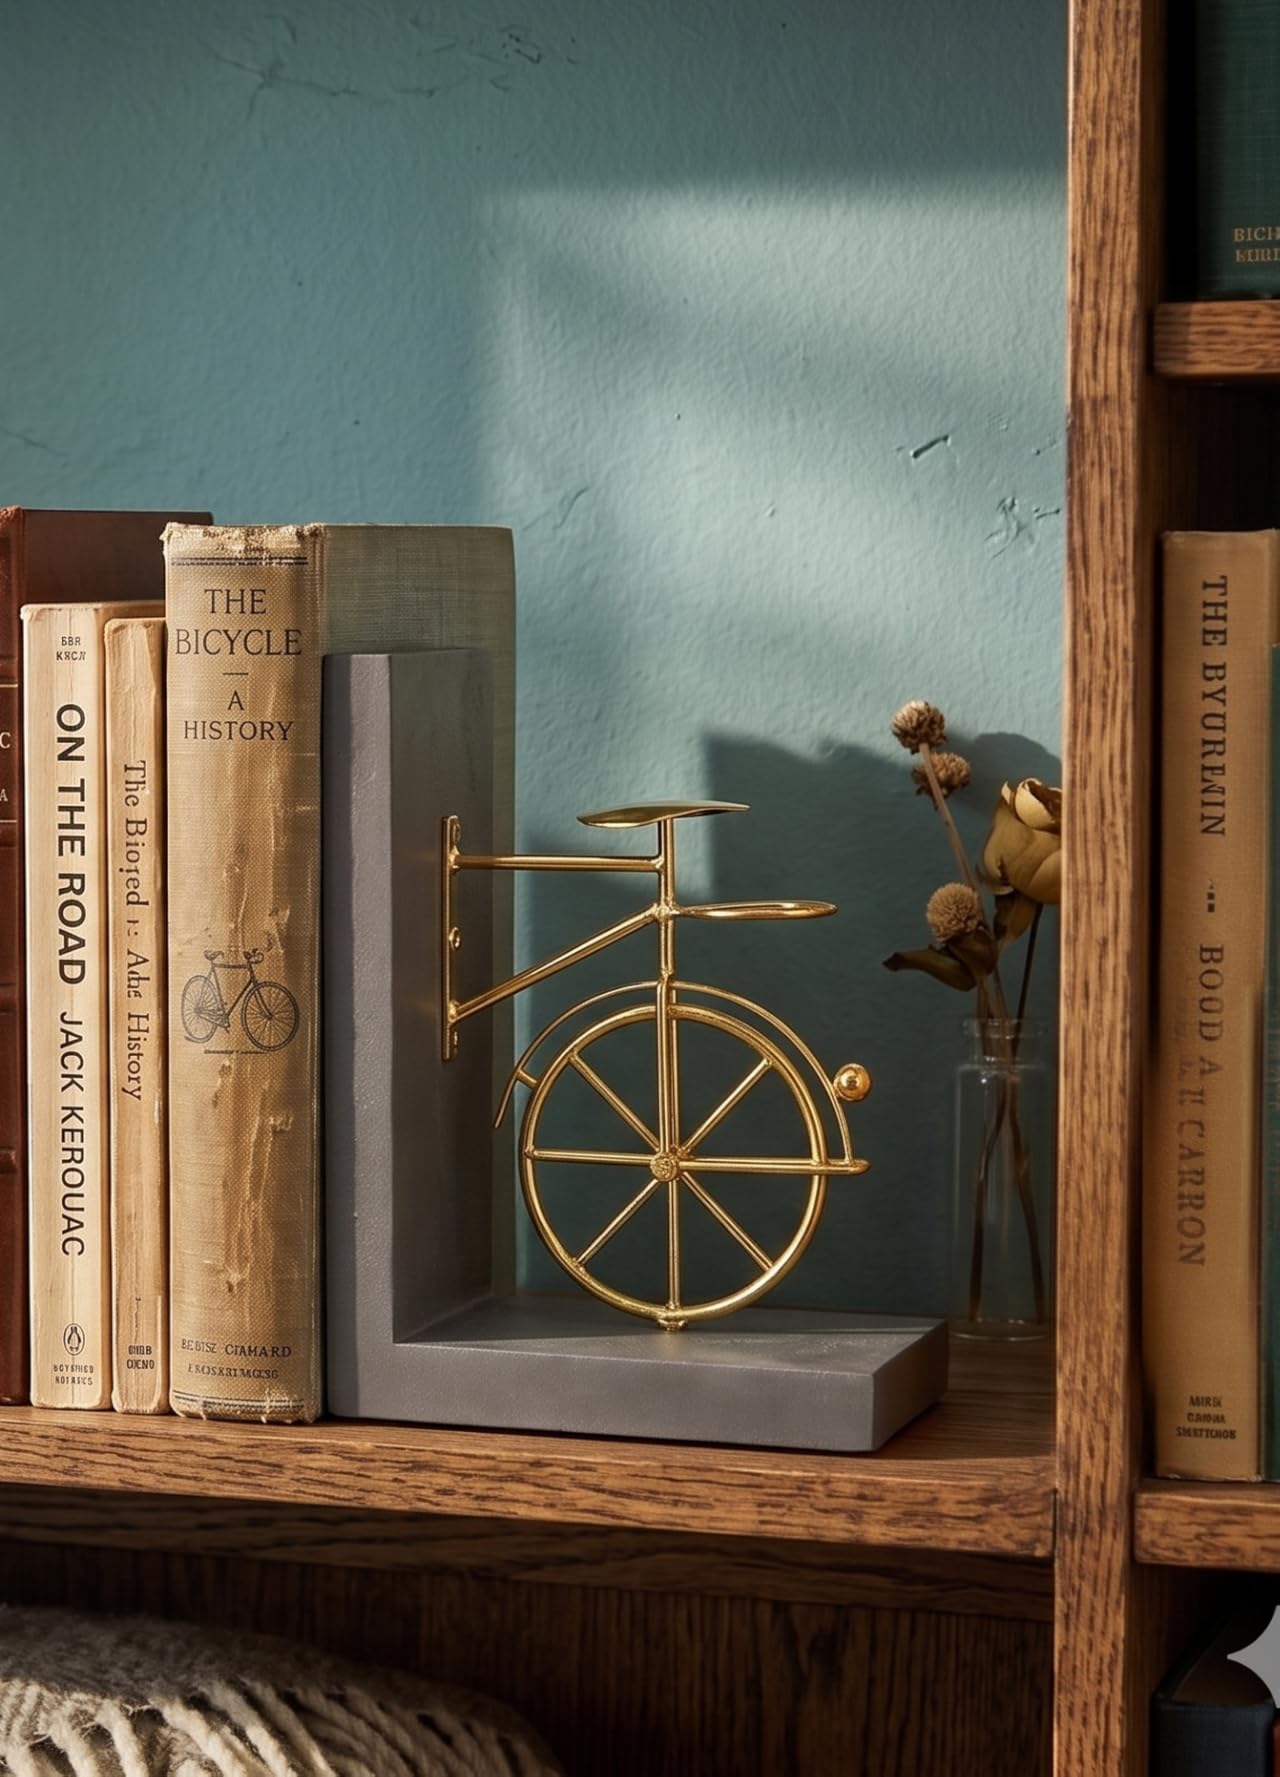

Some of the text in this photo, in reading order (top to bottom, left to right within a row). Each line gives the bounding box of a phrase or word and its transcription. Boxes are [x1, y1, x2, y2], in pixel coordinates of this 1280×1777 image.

[204, 588, 267, 614] THE
[1202, 575, 1228, 647] THE
[175, 628, 303, 656] BICYCLE
[227, 690, 244, 711] A
[183, 720, 294, 741] HISTORY
[124, 760, 148, 808] The
[56, 703, 87, 1257] ON THE ROAD JACK KEROUAC
[122, 1012, 150, 1101] History
